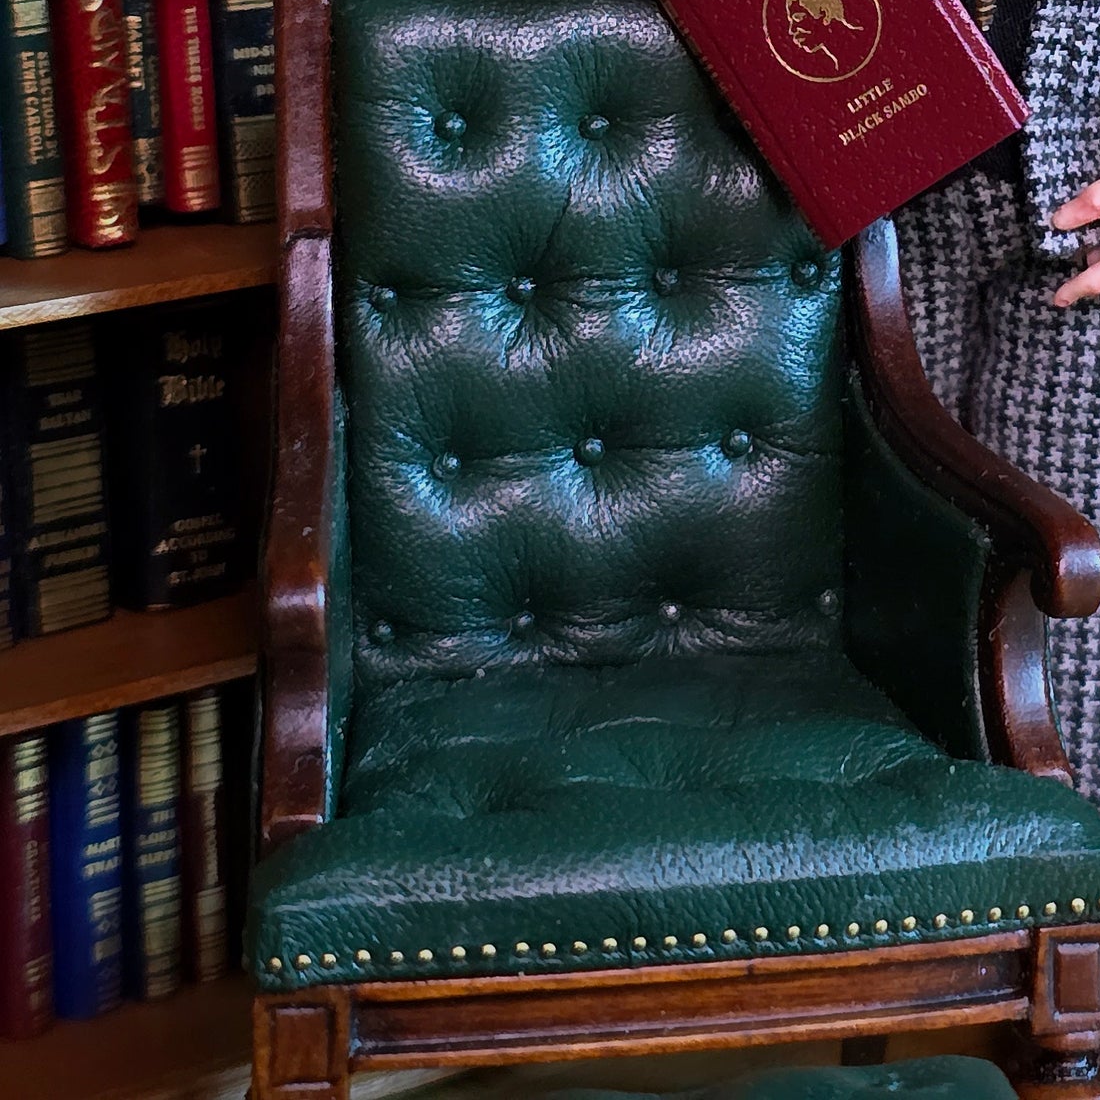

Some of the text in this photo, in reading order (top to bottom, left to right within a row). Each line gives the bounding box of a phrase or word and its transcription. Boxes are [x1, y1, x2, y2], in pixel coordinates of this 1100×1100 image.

[182, 6, 198, 34] THE
[184, 37, 201, 85] THREE
[21, 52, 43, 165] LEWIS CARROLL
[37, 52, 59, 159] SELECTIONS BY
[838, 83, 928, 146] BLACK SAMBO
[847, 78, 894, 113] LITTLE
